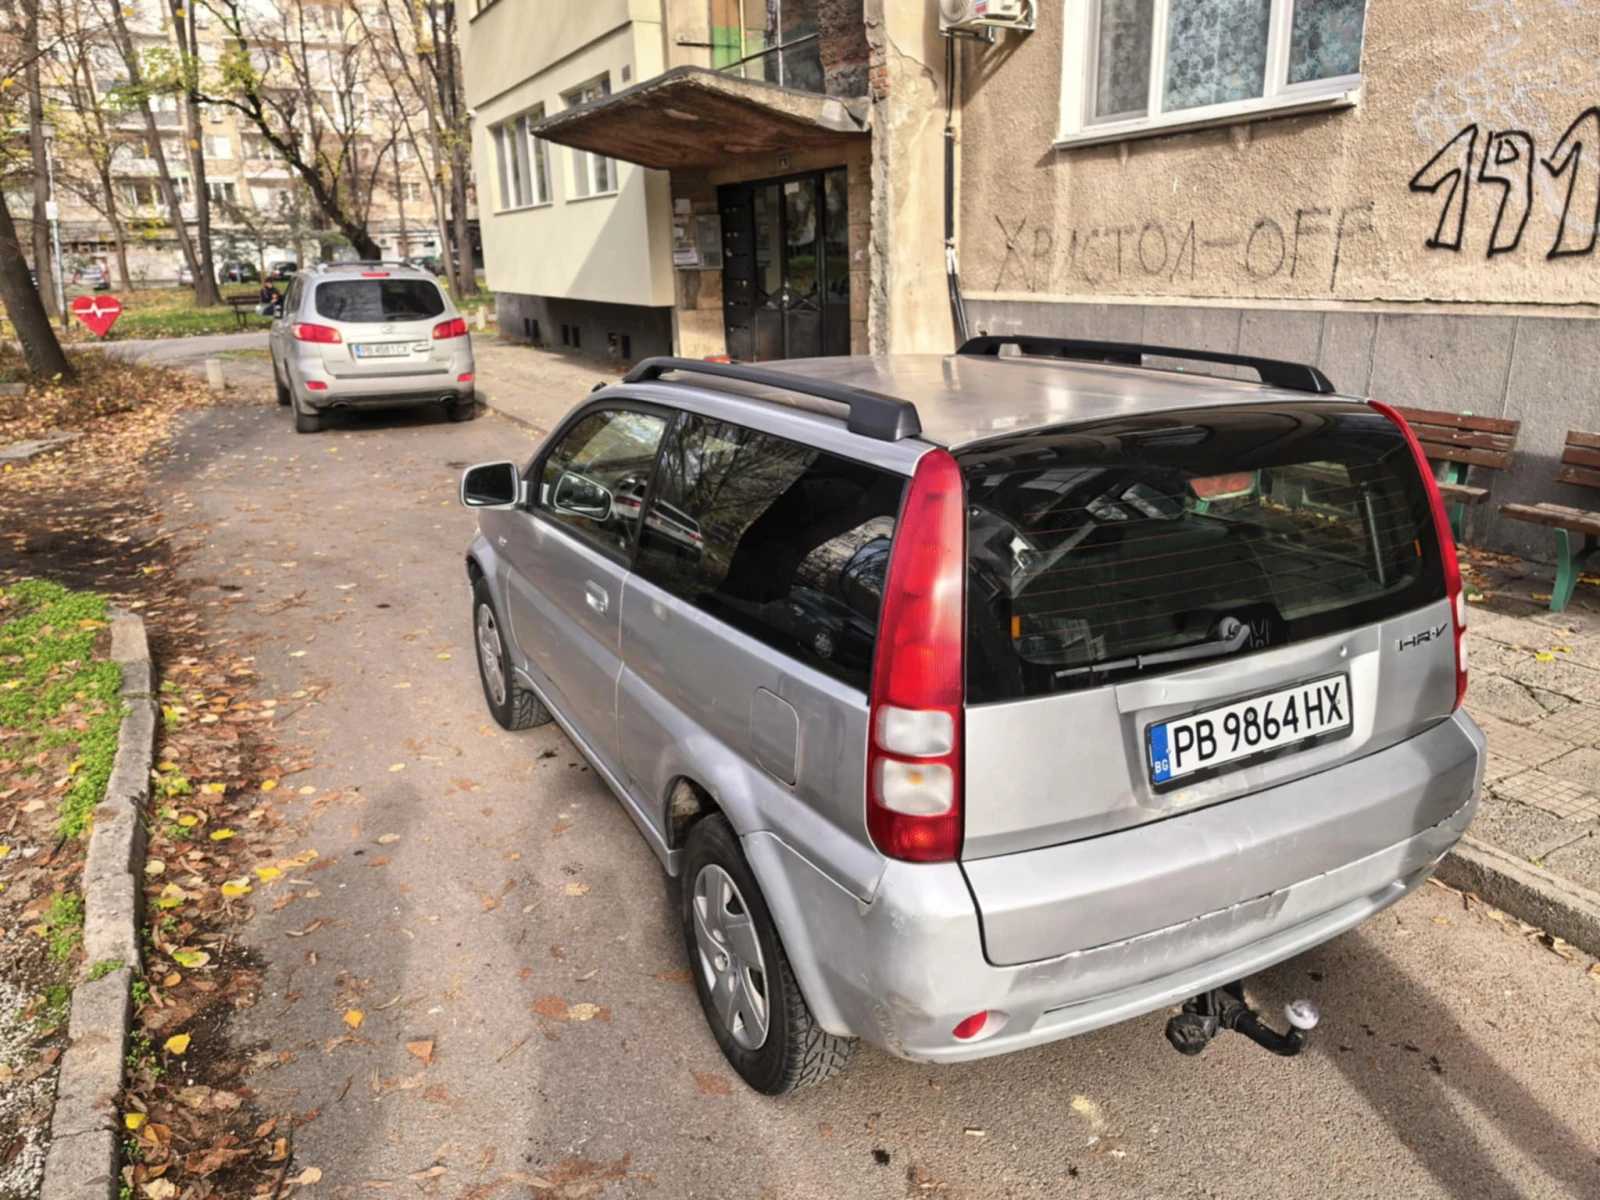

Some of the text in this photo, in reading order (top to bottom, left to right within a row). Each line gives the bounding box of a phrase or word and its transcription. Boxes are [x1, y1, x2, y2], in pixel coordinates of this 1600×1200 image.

[1174, 681, 1344, 768] PB 9864 HX
[1154, 759, 1169, 774] BG
